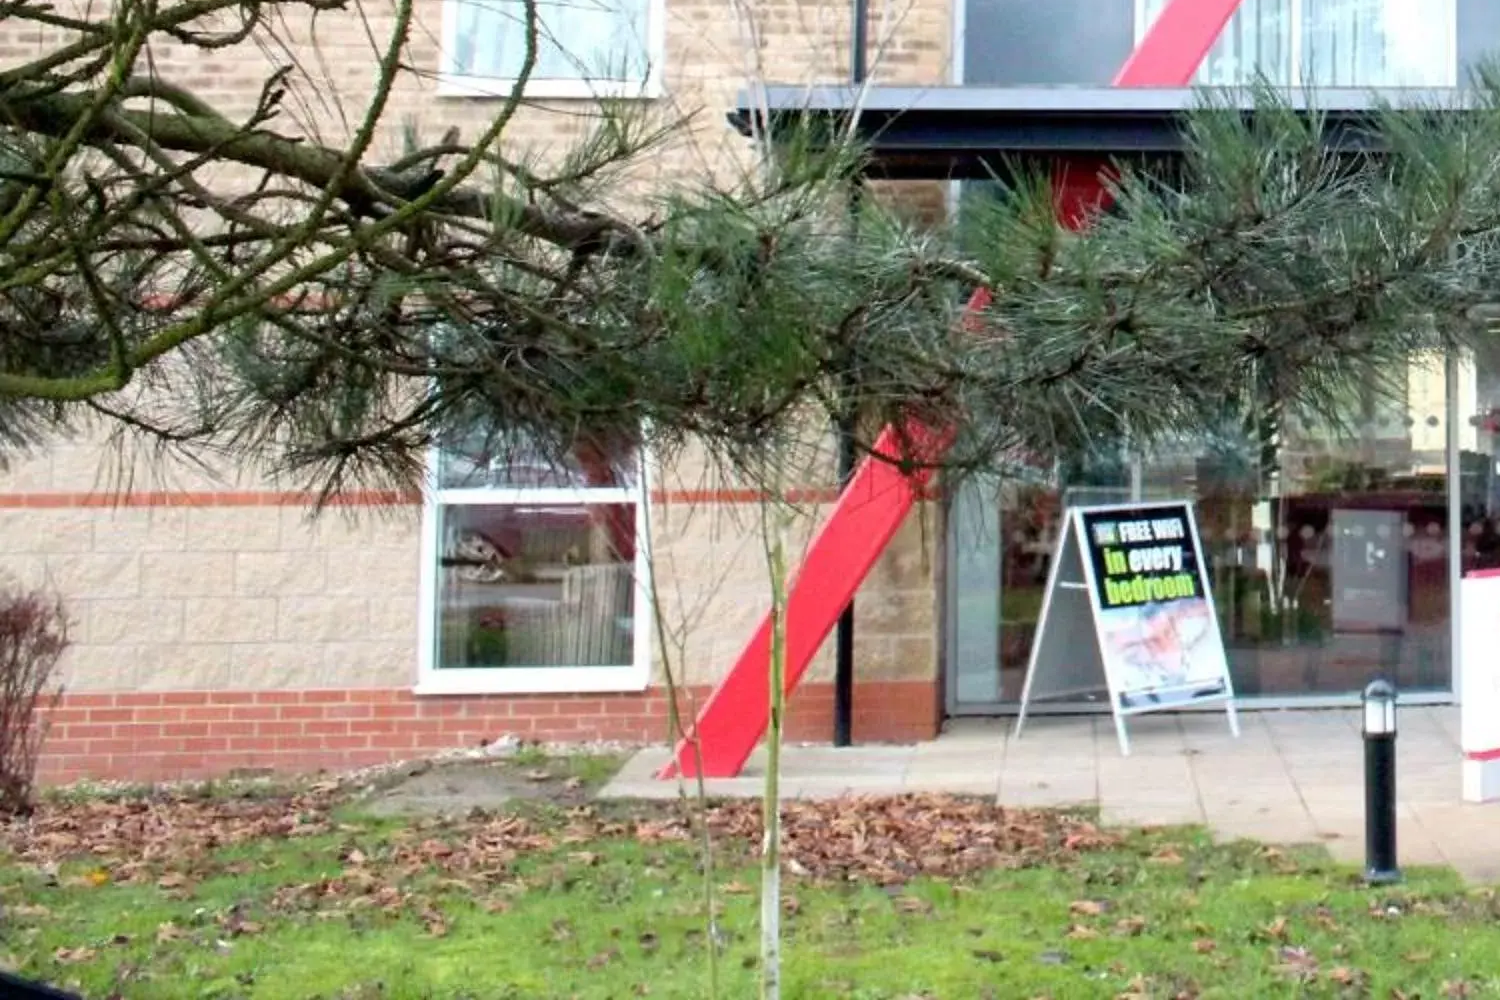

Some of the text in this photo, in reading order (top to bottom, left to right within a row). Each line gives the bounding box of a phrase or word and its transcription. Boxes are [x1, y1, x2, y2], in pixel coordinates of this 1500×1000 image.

[1118, 520, 1153, 543] FREE
[1104, 545, 1182, 574] in every
[1104, 574, 1195, 604] bedroom
